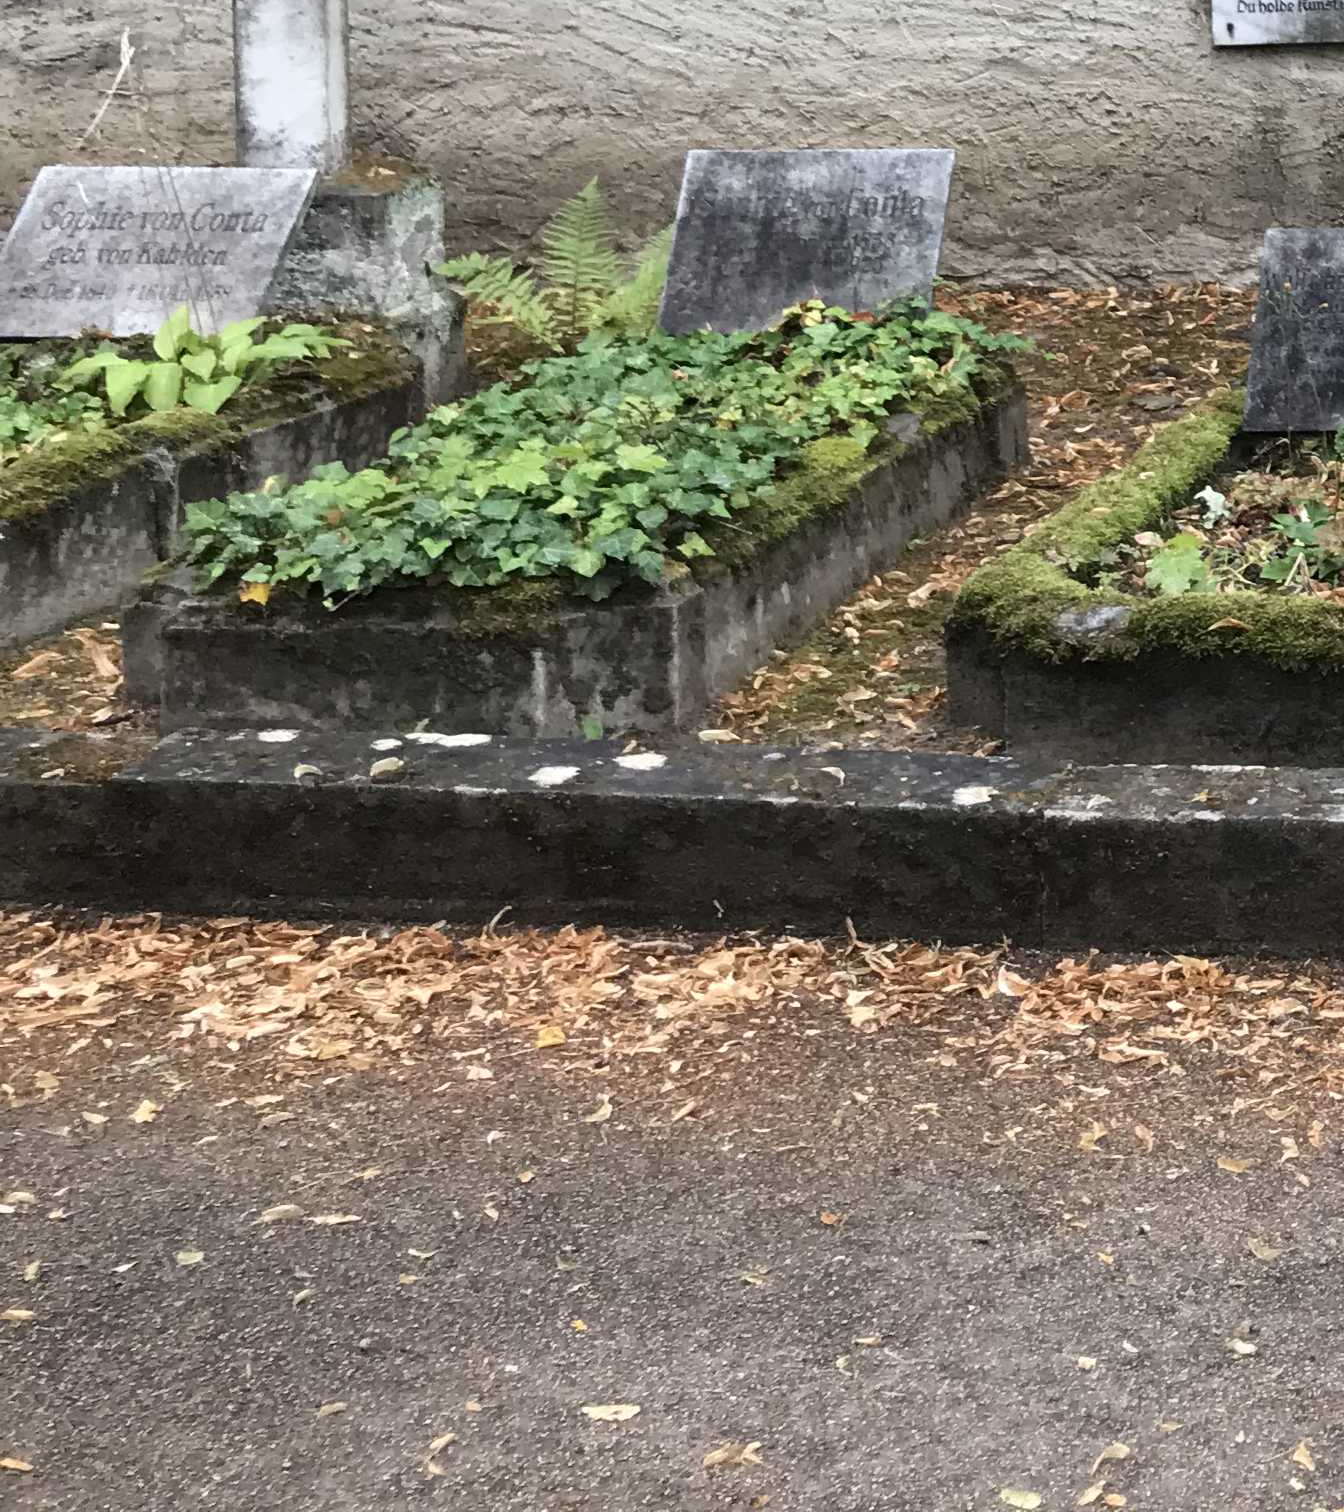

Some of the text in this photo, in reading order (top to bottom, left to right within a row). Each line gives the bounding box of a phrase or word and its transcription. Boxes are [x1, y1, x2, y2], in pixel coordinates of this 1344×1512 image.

[1236, 0, 1256, 13] Du
[1257, 0, 1296, 14] holde
[41, 200, 270, 238] Sophie von Conta
